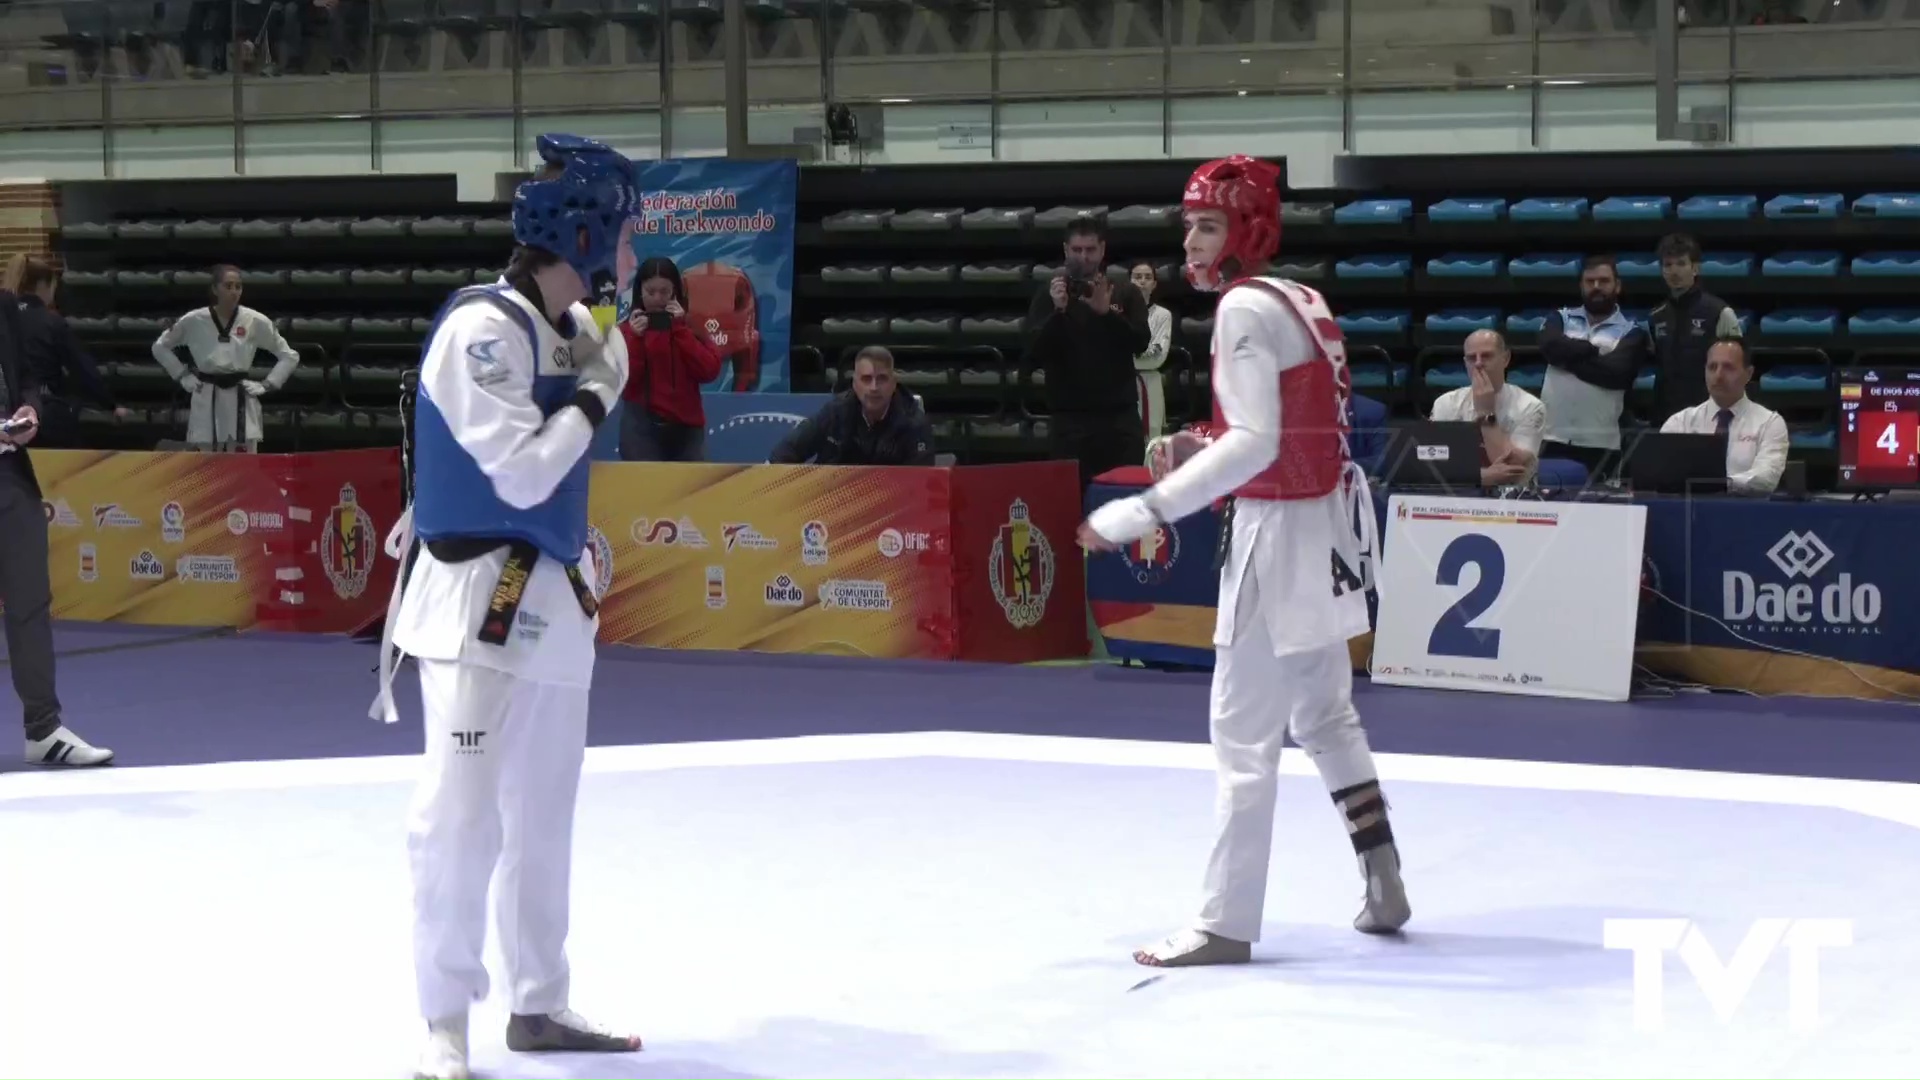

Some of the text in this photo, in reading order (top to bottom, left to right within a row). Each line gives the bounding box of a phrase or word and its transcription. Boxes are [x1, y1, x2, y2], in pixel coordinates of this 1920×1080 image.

[640, 186, 737, 212] ederación
[634, 207, 776, 235] de Taekwondo
[1876, 422, 1900, 454] 4
[189, 562, 233, 571] COMUNITAT
[834, 588, 884, 598] COMUNITAT
[1427, 533, 1505, 659] 2
[838, 598, 889, 607] DE L'ESPORT
[1726, 624, 1881, 634] NTERNATIONAL
